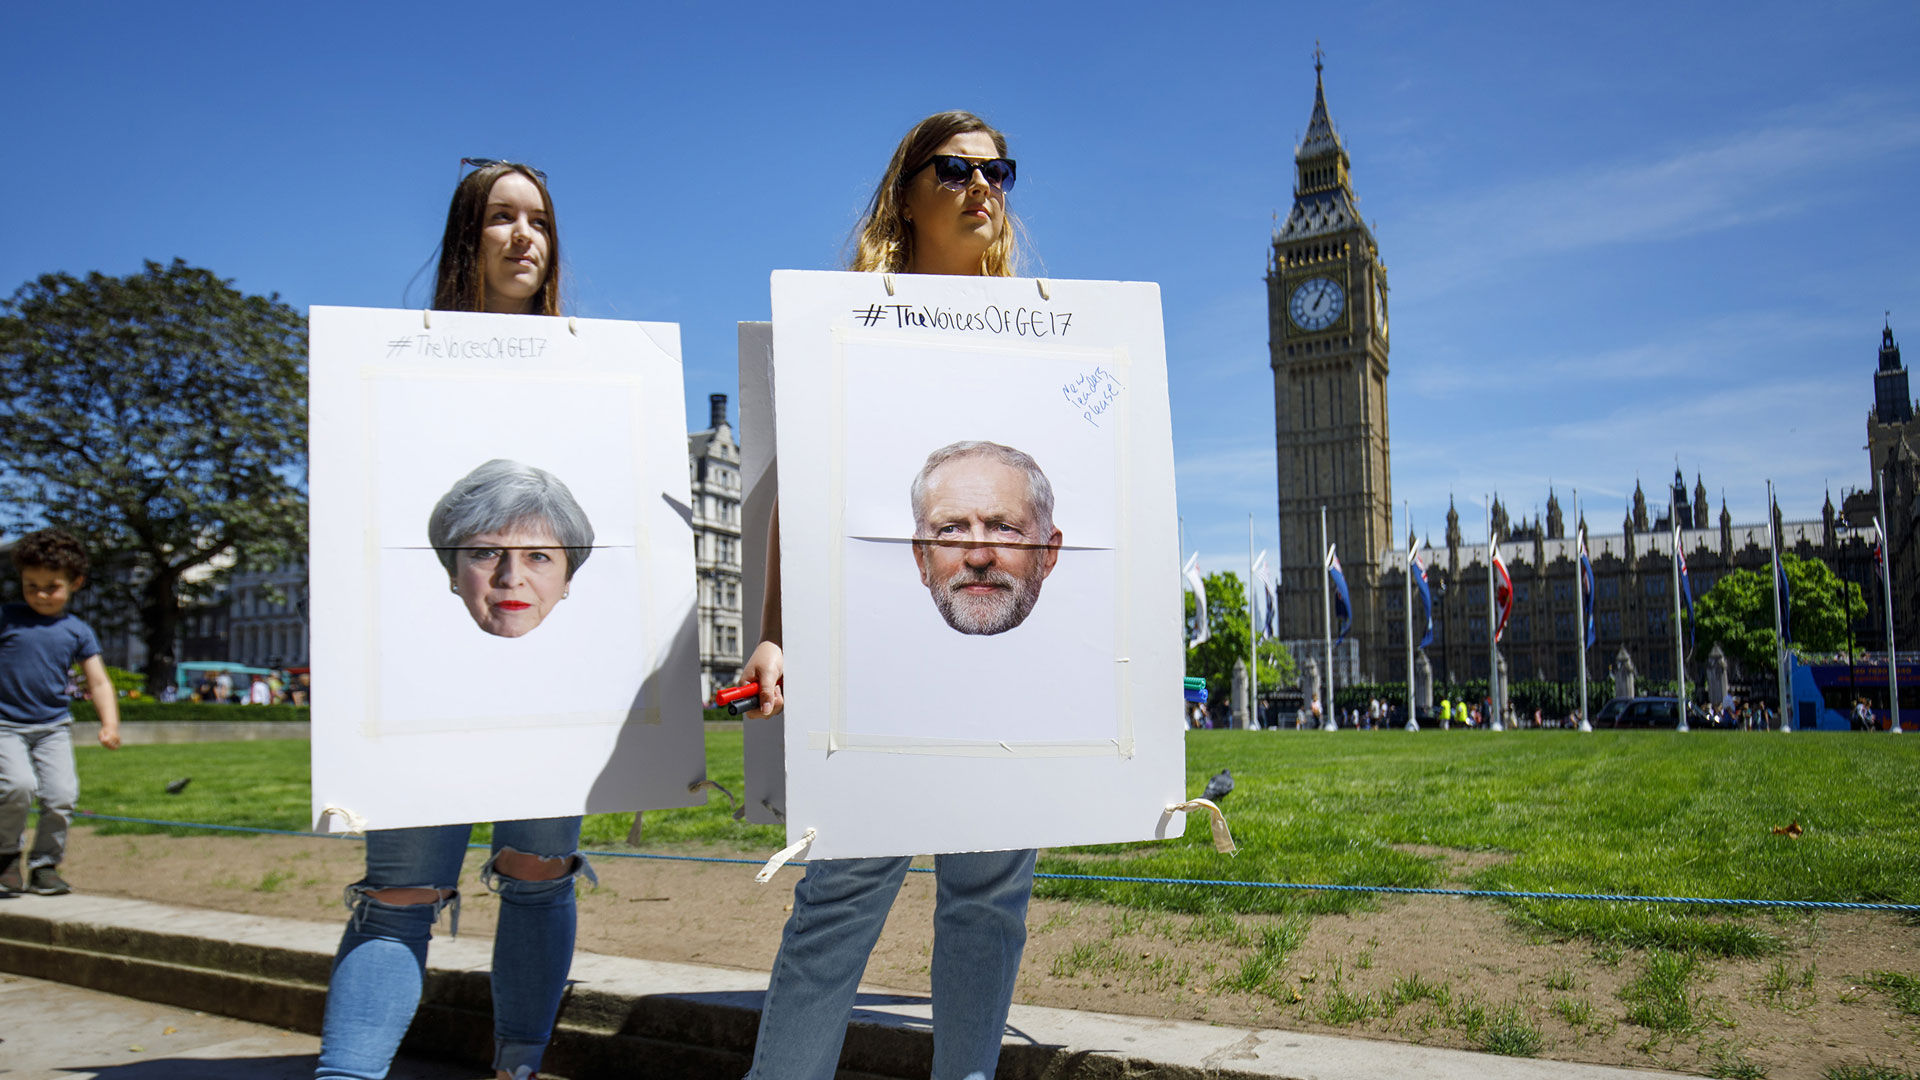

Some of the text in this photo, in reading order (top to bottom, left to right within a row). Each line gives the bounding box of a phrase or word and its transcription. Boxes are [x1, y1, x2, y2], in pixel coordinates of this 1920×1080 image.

[851, 301, 1073, 338] #TheVoicesOfGE17
[387, 335, 547, 359] #TheVoicesOfGE17
[1083, 374, 1126, 428] please!
